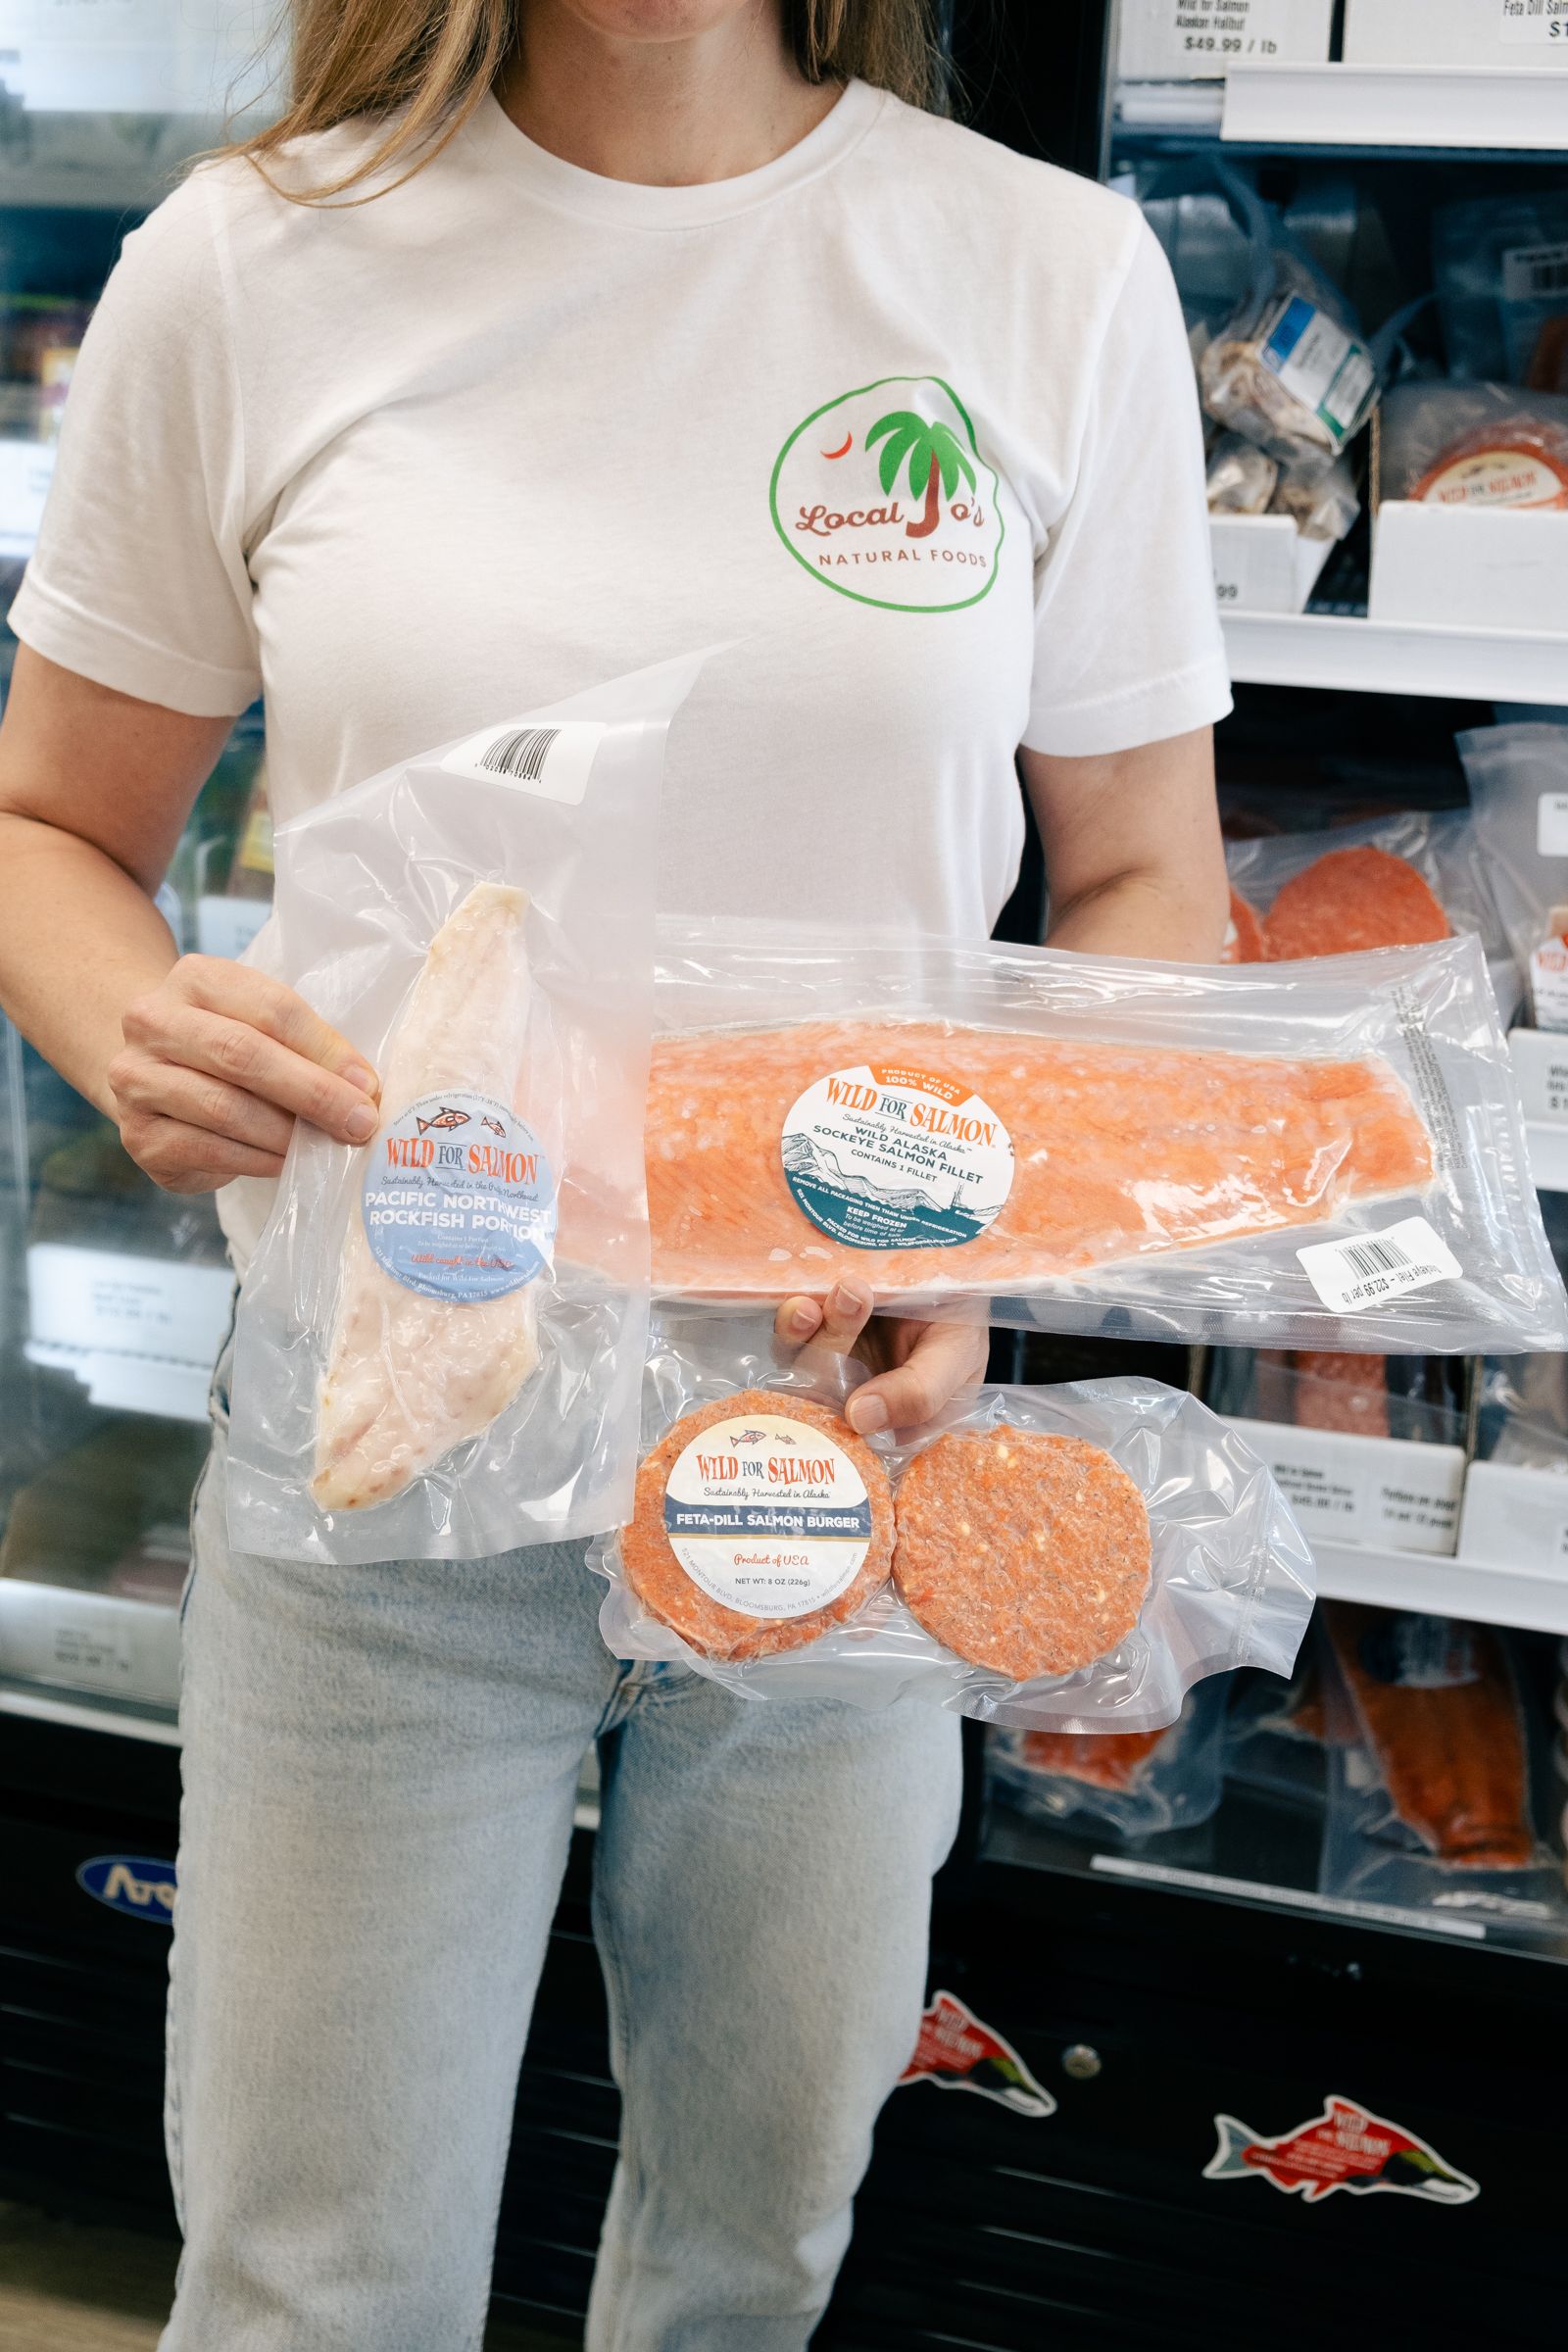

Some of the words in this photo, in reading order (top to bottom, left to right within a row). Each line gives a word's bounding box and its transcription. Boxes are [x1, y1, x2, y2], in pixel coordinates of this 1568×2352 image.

[1184, 36, 1243, 53] $49.99
[1260, 39, 1277, 54] lb
[795, 502, 905, 537] Local
[819, 549, 921, 565] NATURAL
[931, 549, 987, 568] FOODS
[881, 1068, 927, 1079] PRODUCT
[885, 1075, 917, 1087] 100%
[922, 1081, 954, 1100] WILD
[825, 1077, 878, 1112] WILD
[879, 1097, 907, 1120] FOR
[909, 1102, 998, 1148] SALMON
[842, 1113, 887, 1133] Sustainably
[890, 1125, 930, 1143] Harvested
[813, 1124, 875, 1150] SOCKEYE
[878, 1143, 935, 1169] SALMON
[939, 1162, 984, 1185] FILLET
[856, 1126, 889, 1142] WILD
[893, 1138, 947, 1161] ALASKA
[385, 1137, 435, 1170] WILD
[438, 1145, 464, 1171] FOR
[466, 1144, 540, 1186] SALMON
[851, 1149, 898, 1169] CONTAINS
[906, 1166, 938, 1183] FILLET
[381, 1176, 423, 1190] Sustainably
[365, 1190, 437, 1207] PACIFIC
[443, 1195, 553, 1224] NORTHWEST
[792, 1176, 817, 1190] REMOVE
[817, 1183, 829, 1194] ALL
[830, 1190, 863, 1205] PACKAGING
[881, 1207, 899, 1218] THAW
[369, 1209, 466, 1229] ROCKFISH
[826, 1217, 848, 1234] PACKED
[847, 1230, 859, 1240] FOR
[847, 1205, 870, 1218] KEEP
[871, 1213, 907, 1229] FROZEN
[1342, 1292, 1352, 1305] lb
[1352, 1284, 1364, 1299] per
[1364, 1277, 1390, 1297] $22.99
[696, 1454, 738, 1482] WILD
[742, 1460, 764, 1480] FOR
[767, 1456, 835, 1486] SALMON
[704, 1487, 749, 1500] Sustainably
[752, 1488, 792, 1498] Harvested
[793, 1490, 802, 1498] in
[803, 1489, 830, 1499] Alaska
[676, 1513, 743, 1526] FETA-DILL
[747, 1515, 804, 1528] SALMON
[807, 1516, 860, 1529] BURGER
[734, 1553, 771, 1566] Product
[771, 1554, 782, 1567] of
[783, 1554, 809, 1566] USA
[689, 1559, 716, 1590] MONTOUR
[787, 1578, 810, 1588] (226g)
